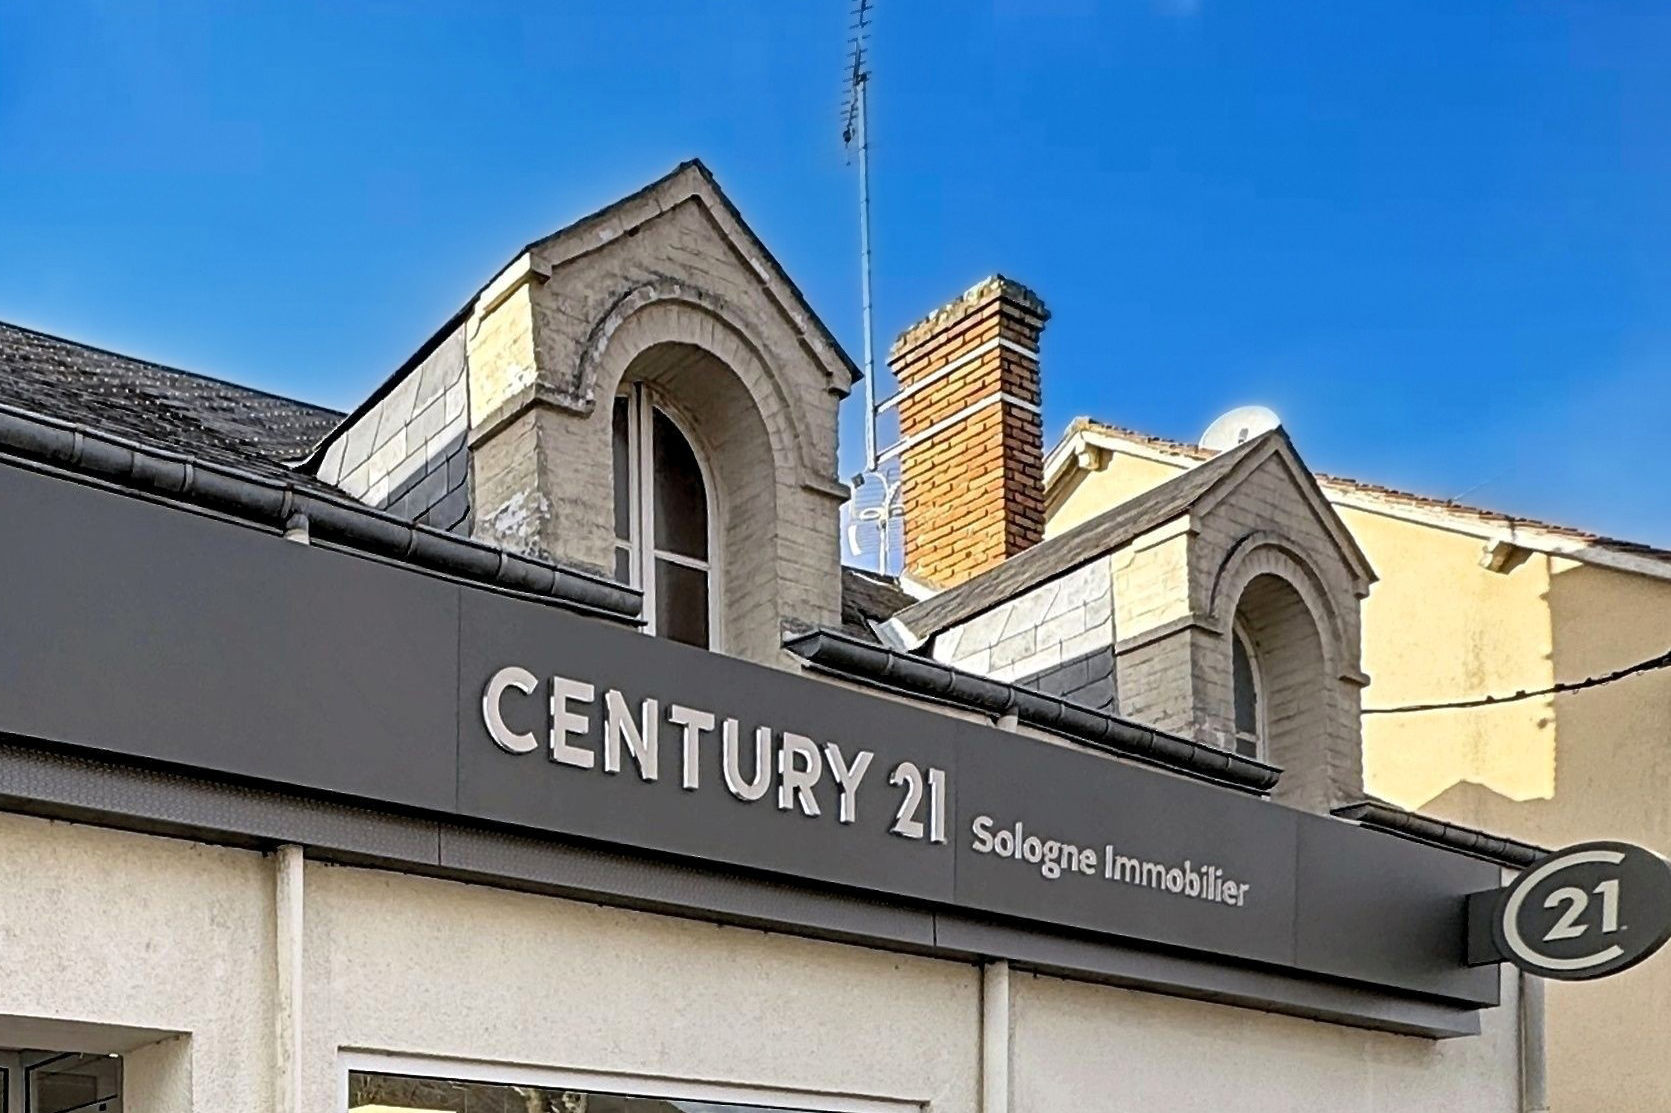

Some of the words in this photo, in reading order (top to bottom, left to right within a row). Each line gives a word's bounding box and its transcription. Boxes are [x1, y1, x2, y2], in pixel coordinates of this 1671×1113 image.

[482, 666, 874, 825] CENTURY
[889, 761, 947, 844] 21
[972, 815, 1097, 879] Sologne
[1105, 844, 1250, 907] Immobilier
